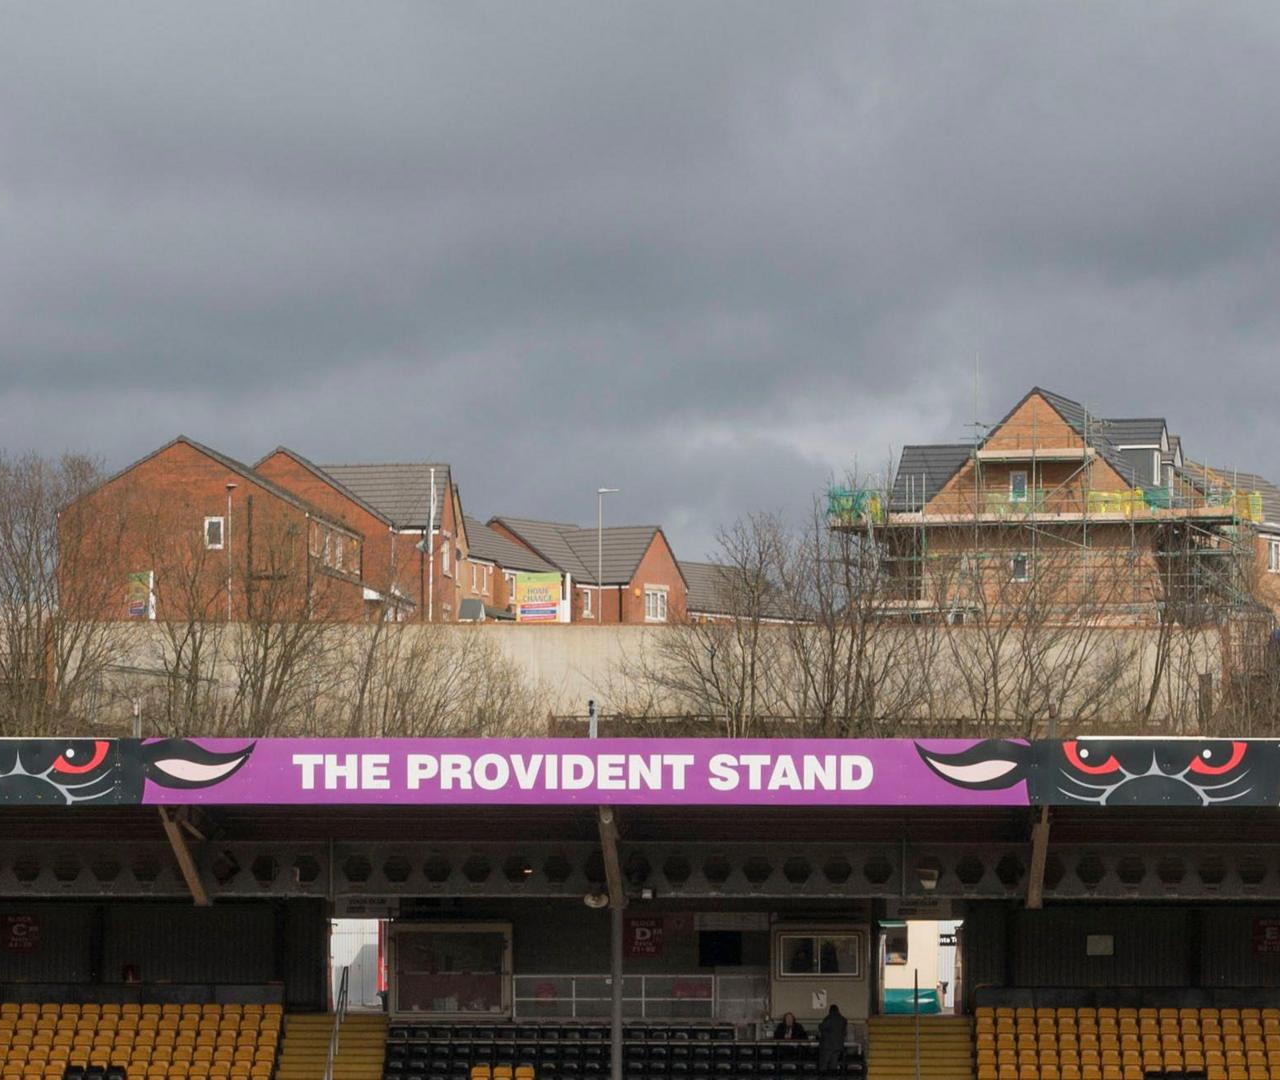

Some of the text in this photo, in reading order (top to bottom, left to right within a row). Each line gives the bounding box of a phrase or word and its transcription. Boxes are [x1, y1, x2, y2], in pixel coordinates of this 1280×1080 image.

[293, 754, 875, 790] THE PROVIDENT STAND
[12, 923, 27, 936] C
[635, 927, 651, 940] D
